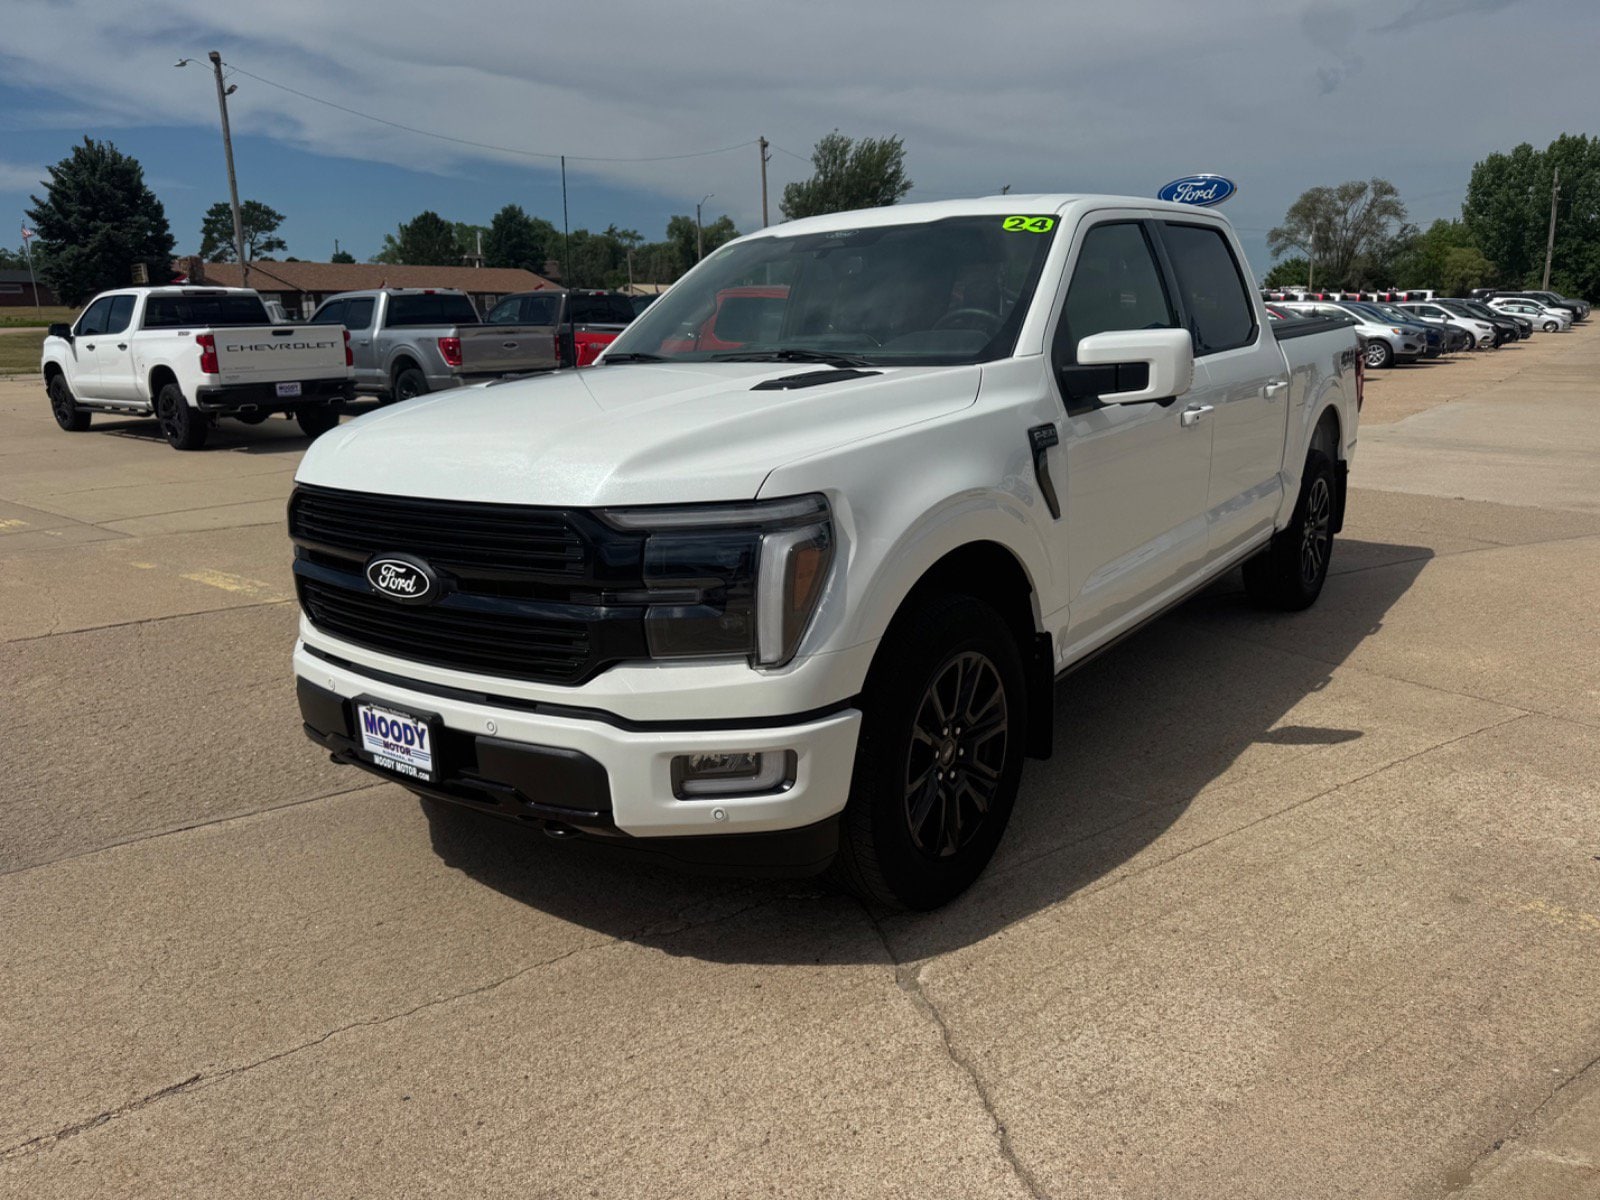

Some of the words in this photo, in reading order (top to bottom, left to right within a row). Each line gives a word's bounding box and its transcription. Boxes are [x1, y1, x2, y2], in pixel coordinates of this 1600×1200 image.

[1173, 181, 1218, 202] Ford
[1006, 217, 1049, 231] 24
[226, 341, 337, 353] CHEVROLET
[378, 563, 417, 593] Ford
[363, 711, 427, 750] MOODY
[382, 740, 412, 756] MOTOR
[373, 754, 395, 769] MOODY
